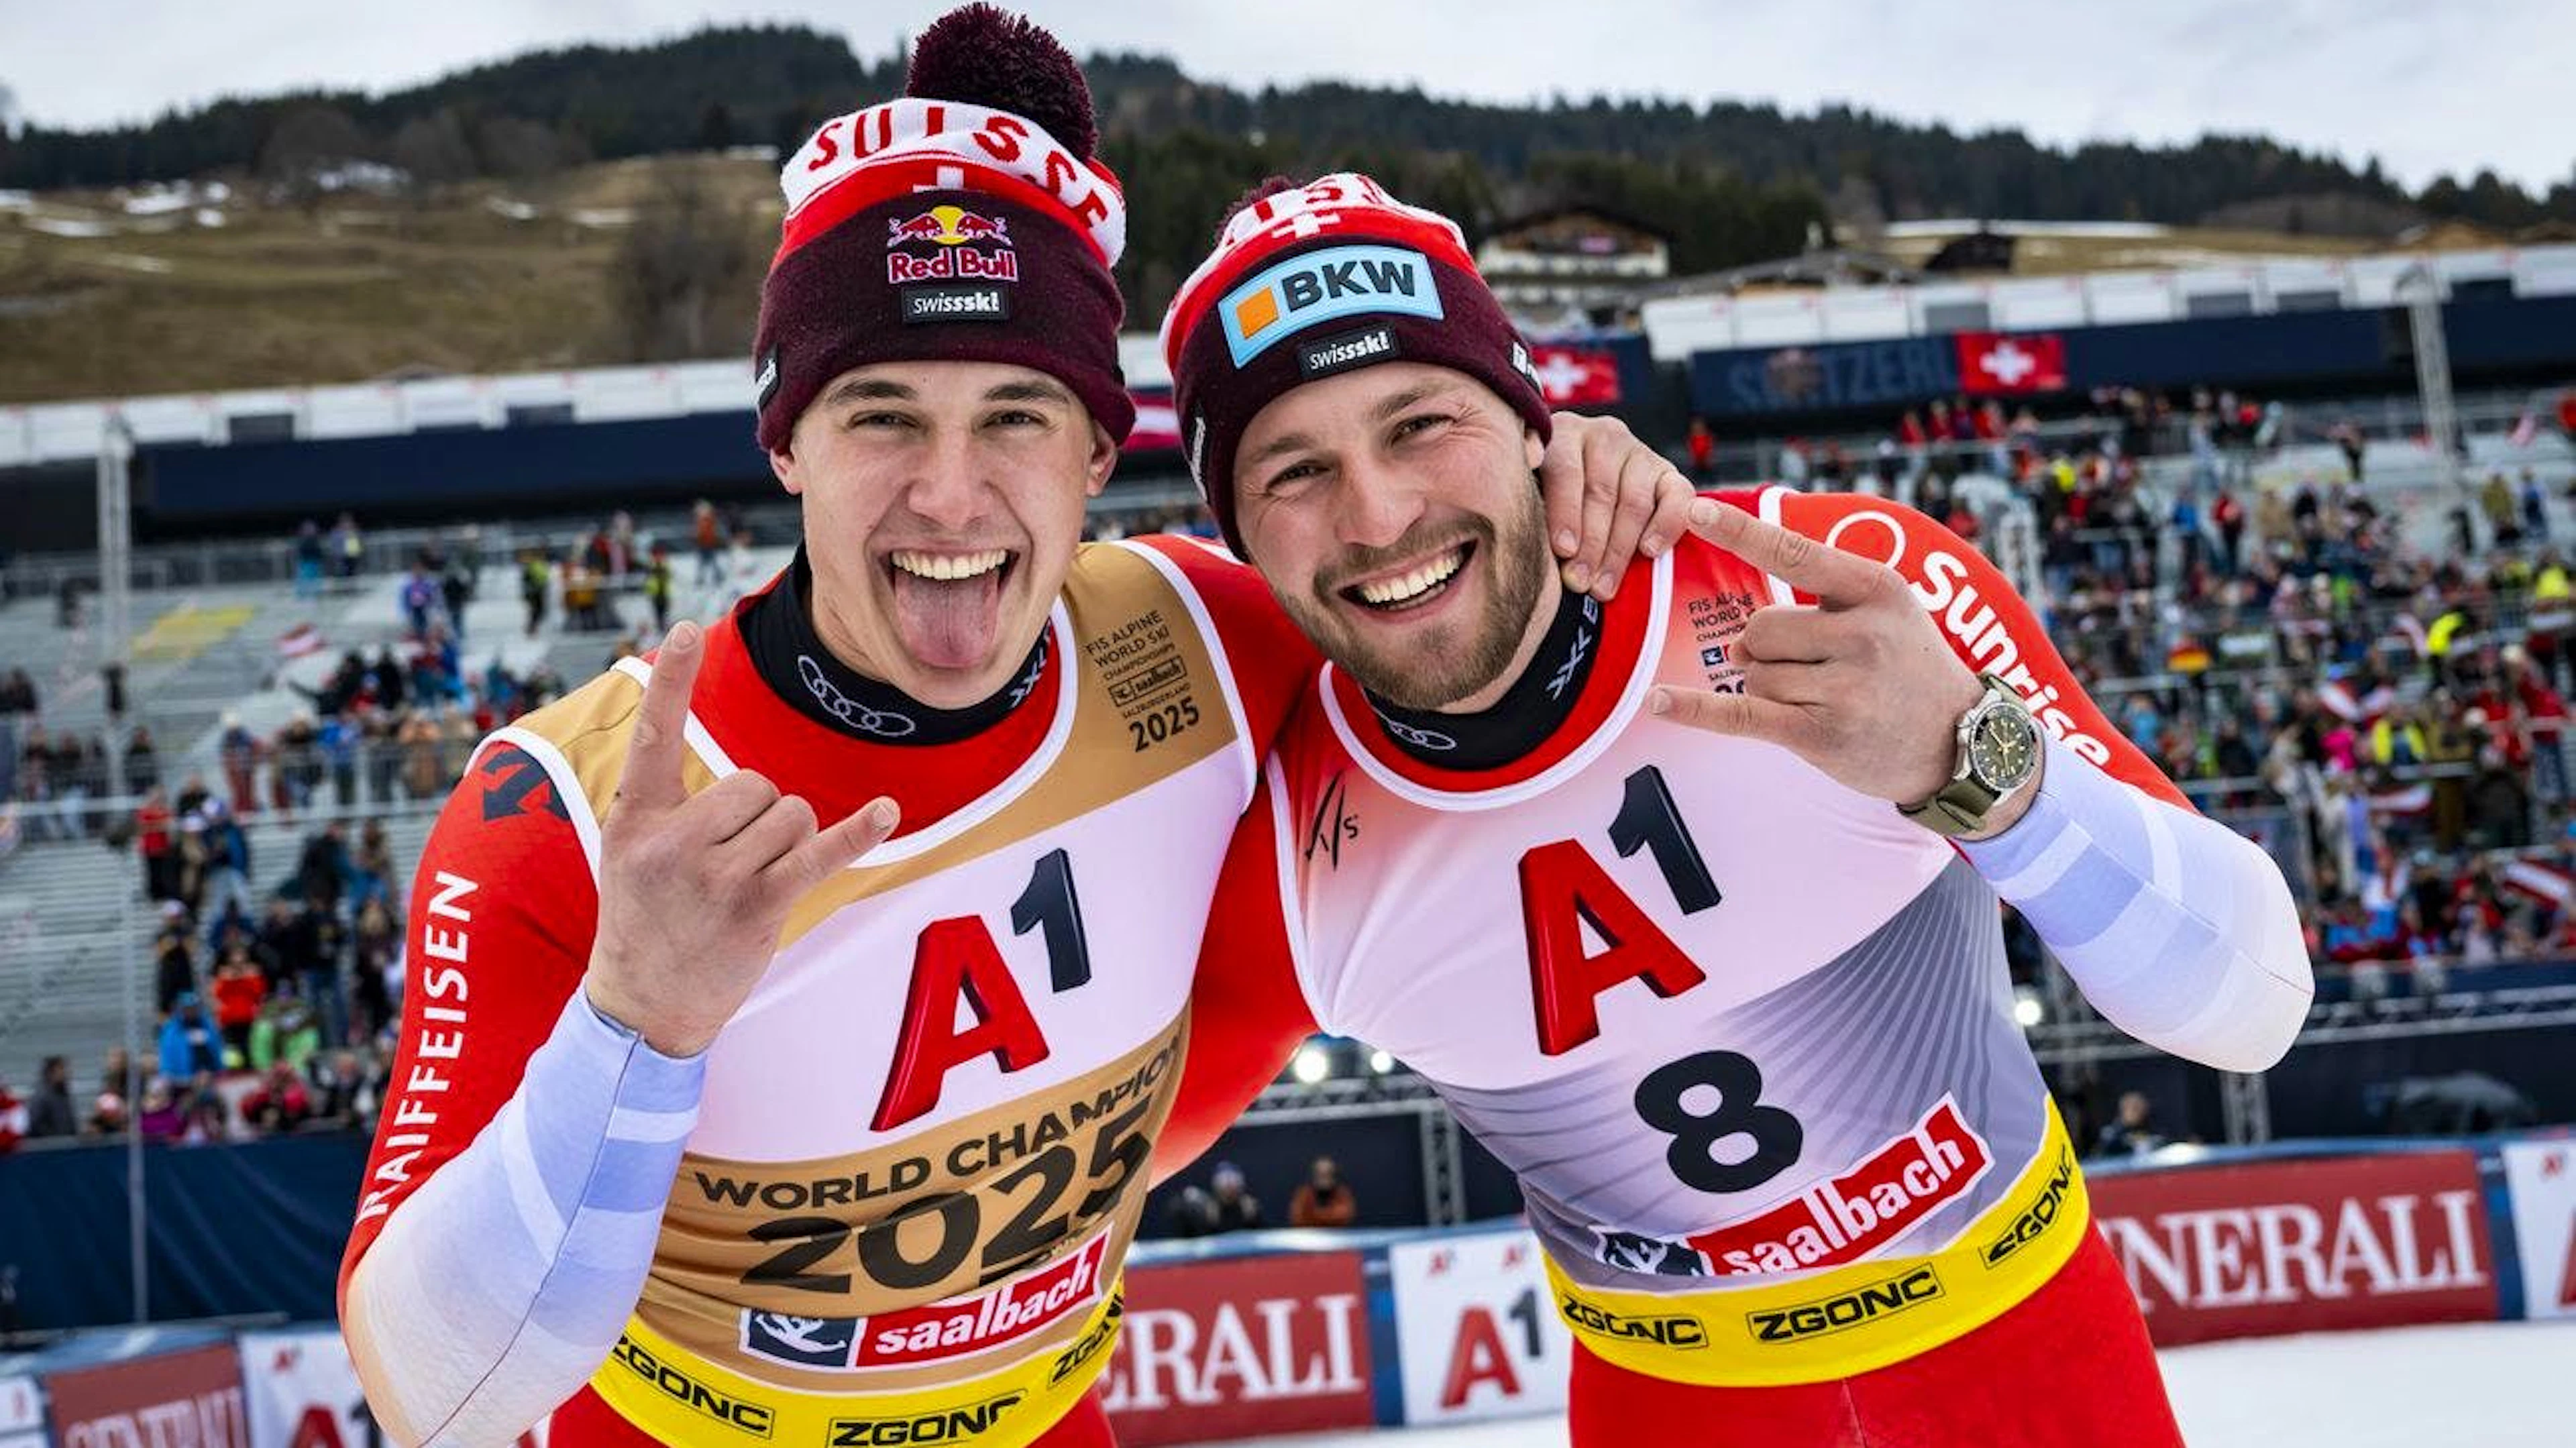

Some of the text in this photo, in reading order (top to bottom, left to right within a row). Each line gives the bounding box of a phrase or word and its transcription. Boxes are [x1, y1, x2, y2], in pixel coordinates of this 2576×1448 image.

[888, 247, 1018, 284] Red Bull
[1281, 260, 1415, 311] BKW
[913, 291, 1000, 314] swissski
[1309, 331, 1391, 370] swissski
[1086, 609, 1163, 655] FIS ALPINE
[1688, 598, 1712, 614] FIS
[1692, 606, 1741, 629] WORLD
[1095, 624, 1170, 667] WORLD SKI
[1909, 551, 2110, 767] Sunrise
[1129, 695, 1199, 753] 2025
[1518, 764, 1722, 1056] A1
[869, 847, 1091, 1132] A1
[354, 870, 478, 1226] RAIFFEISEN
[1634, 1050, 1804, 1194] 8
[695, 1157, 932, 1209] WORLD
[739, 1093, 1152, 1294] 2025
[1722, 1128, 1966, 1276] saalbach
[874, 1245, 1093, 1355] saalbach
[1562, 1292, 1703, 1345] ZGONC
[1752, 1270, 1939, 1344] ZGONC
[1440, 1287, 1542, 1409] A1
